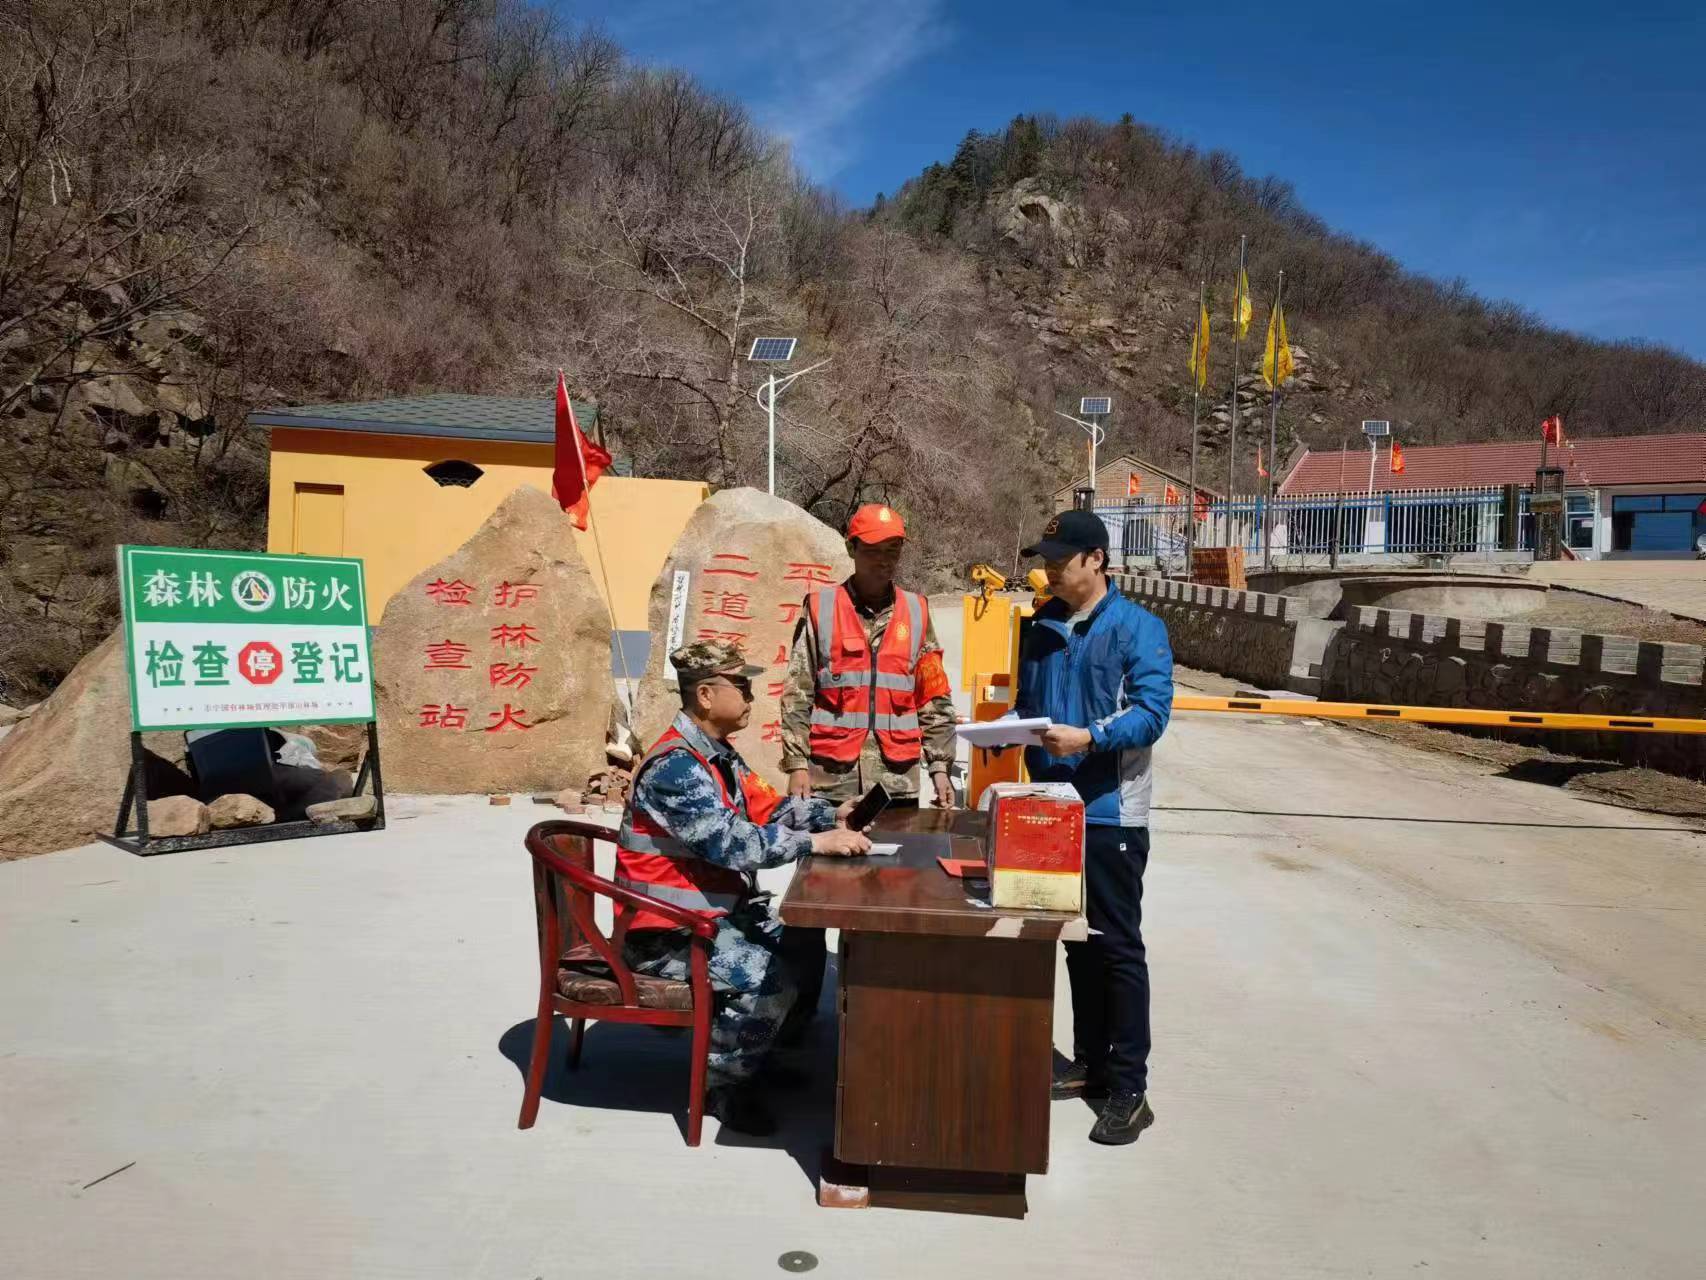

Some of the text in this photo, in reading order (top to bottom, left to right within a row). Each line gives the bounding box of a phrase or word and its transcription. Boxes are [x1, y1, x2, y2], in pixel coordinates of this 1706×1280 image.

[143, 569, 224, 608] 森林
[282, 576, 353, 612] 防火
[145, 639, 364, 689] 检查 停 登记
[419, 578, 477, 729] 检查站
[485, 580, 543, 733] 护林防火
